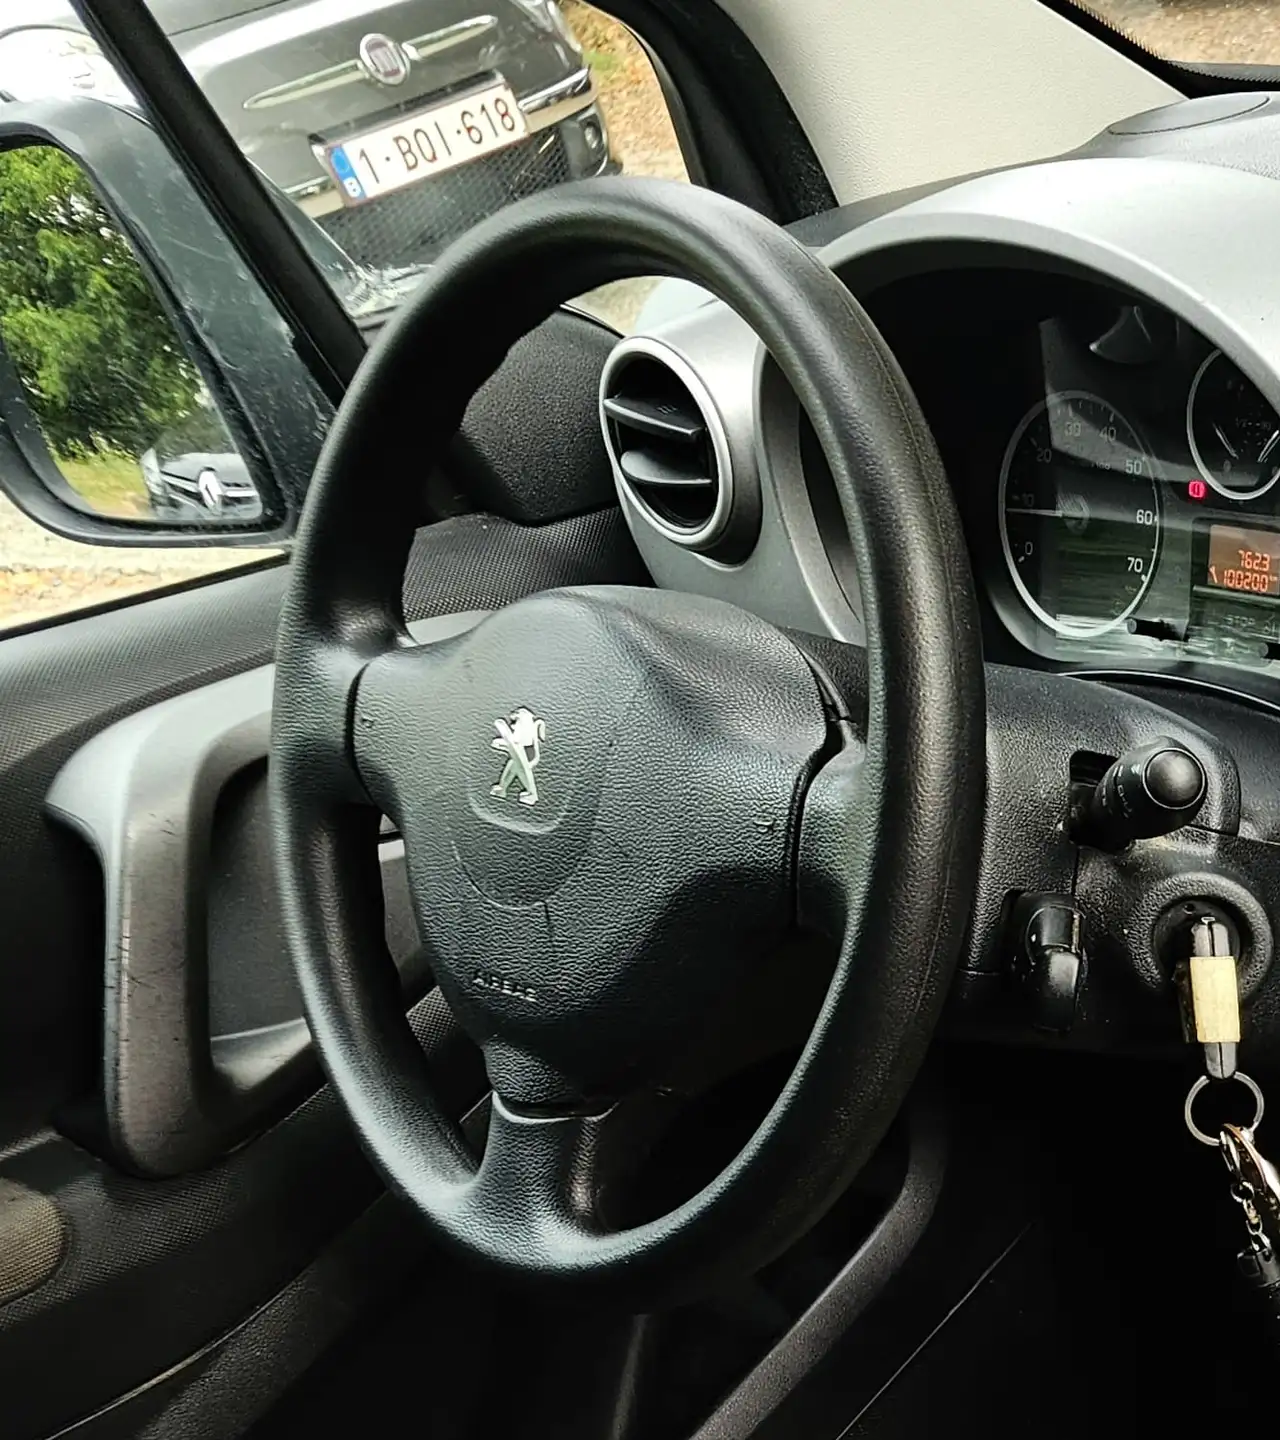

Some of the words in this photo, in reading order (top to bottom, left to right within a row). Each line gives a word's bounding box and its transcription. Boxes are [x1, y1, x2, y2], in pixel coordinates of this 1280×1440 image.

[1125, 459, 1143, 476] 50
[1136, 509, 1154, 526] 60
[1024, 541, 1034, 556] 0
[1127, 557, 1144, 573] 70
[1223, 568, 1268, 593] 100200
